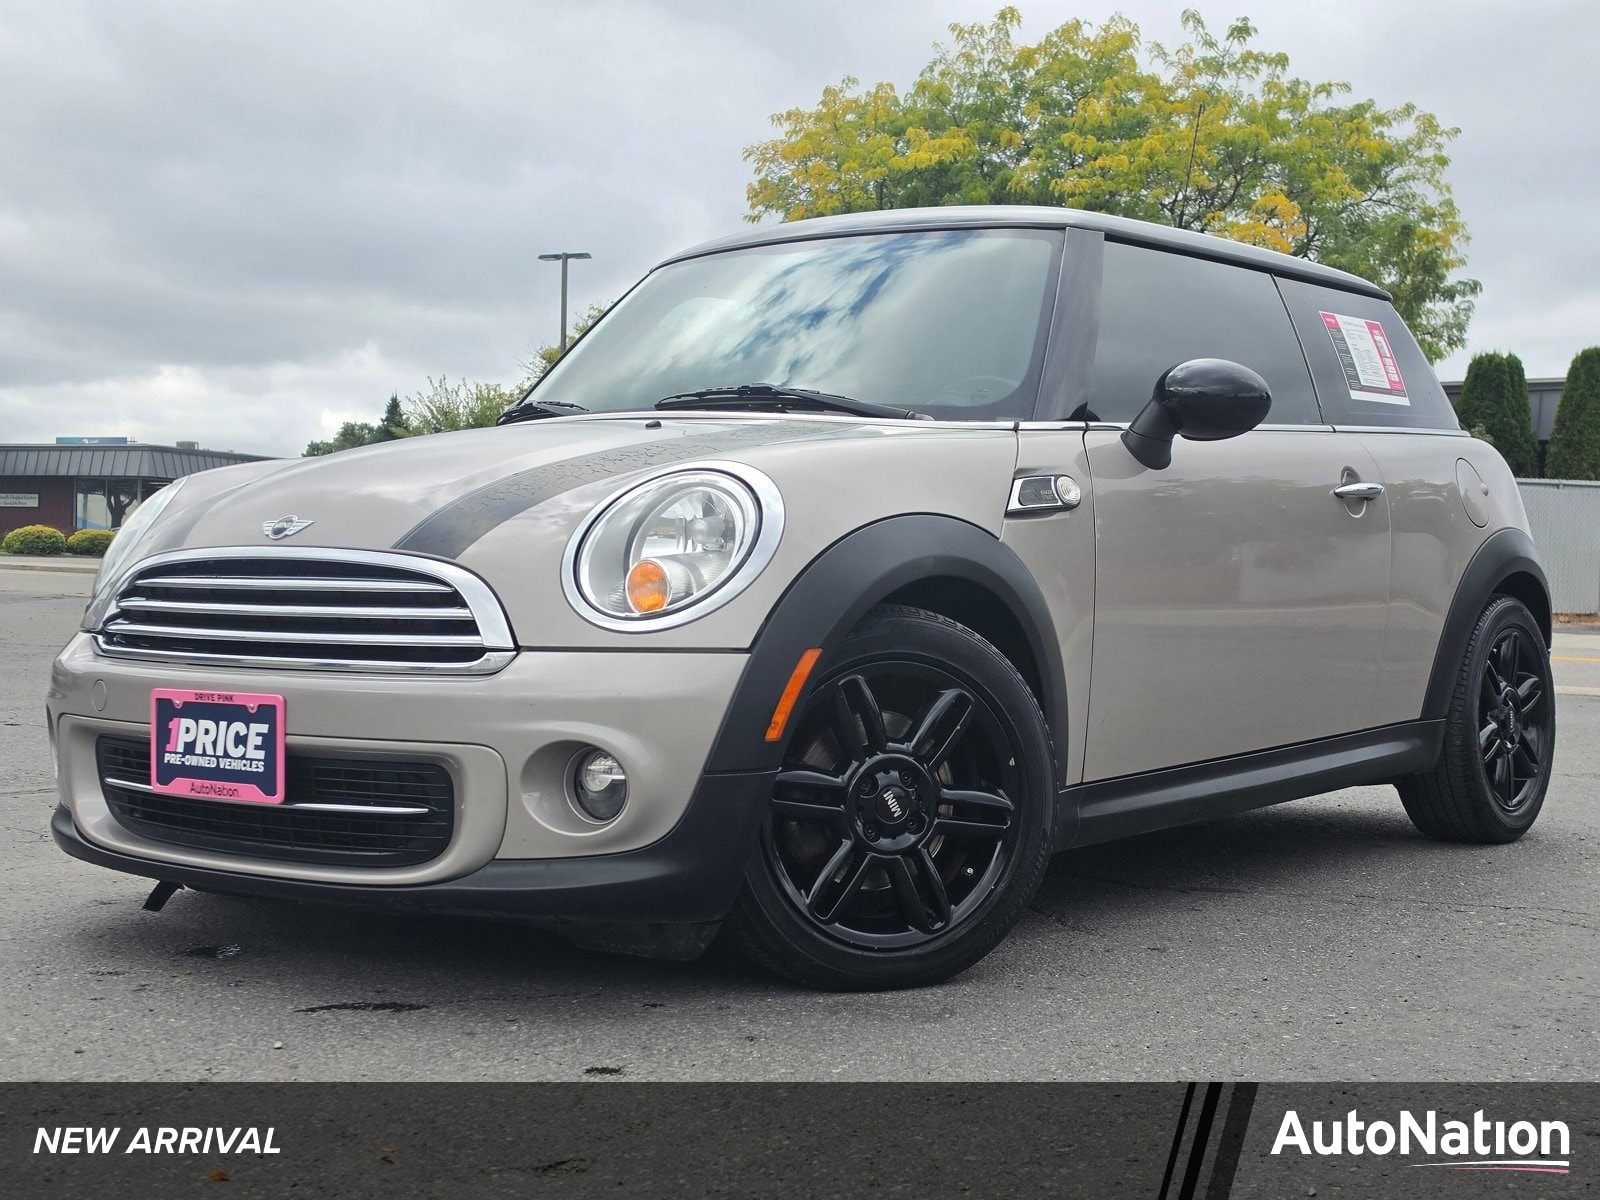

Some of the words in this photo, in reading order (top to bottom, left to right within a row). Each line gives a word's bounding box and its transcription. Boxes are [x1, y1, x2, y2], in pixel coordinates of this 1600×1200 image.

[194, 692, 216, 701] DRIVE
[217, 694, 234, 702] PINK
[163, 753, 217, 768] PRE-OWNED
[218, 757, 265, 773] VEHICLES
[189, 782, 240, 798] AutoNation
[883, 790, 903, 818] MINI
